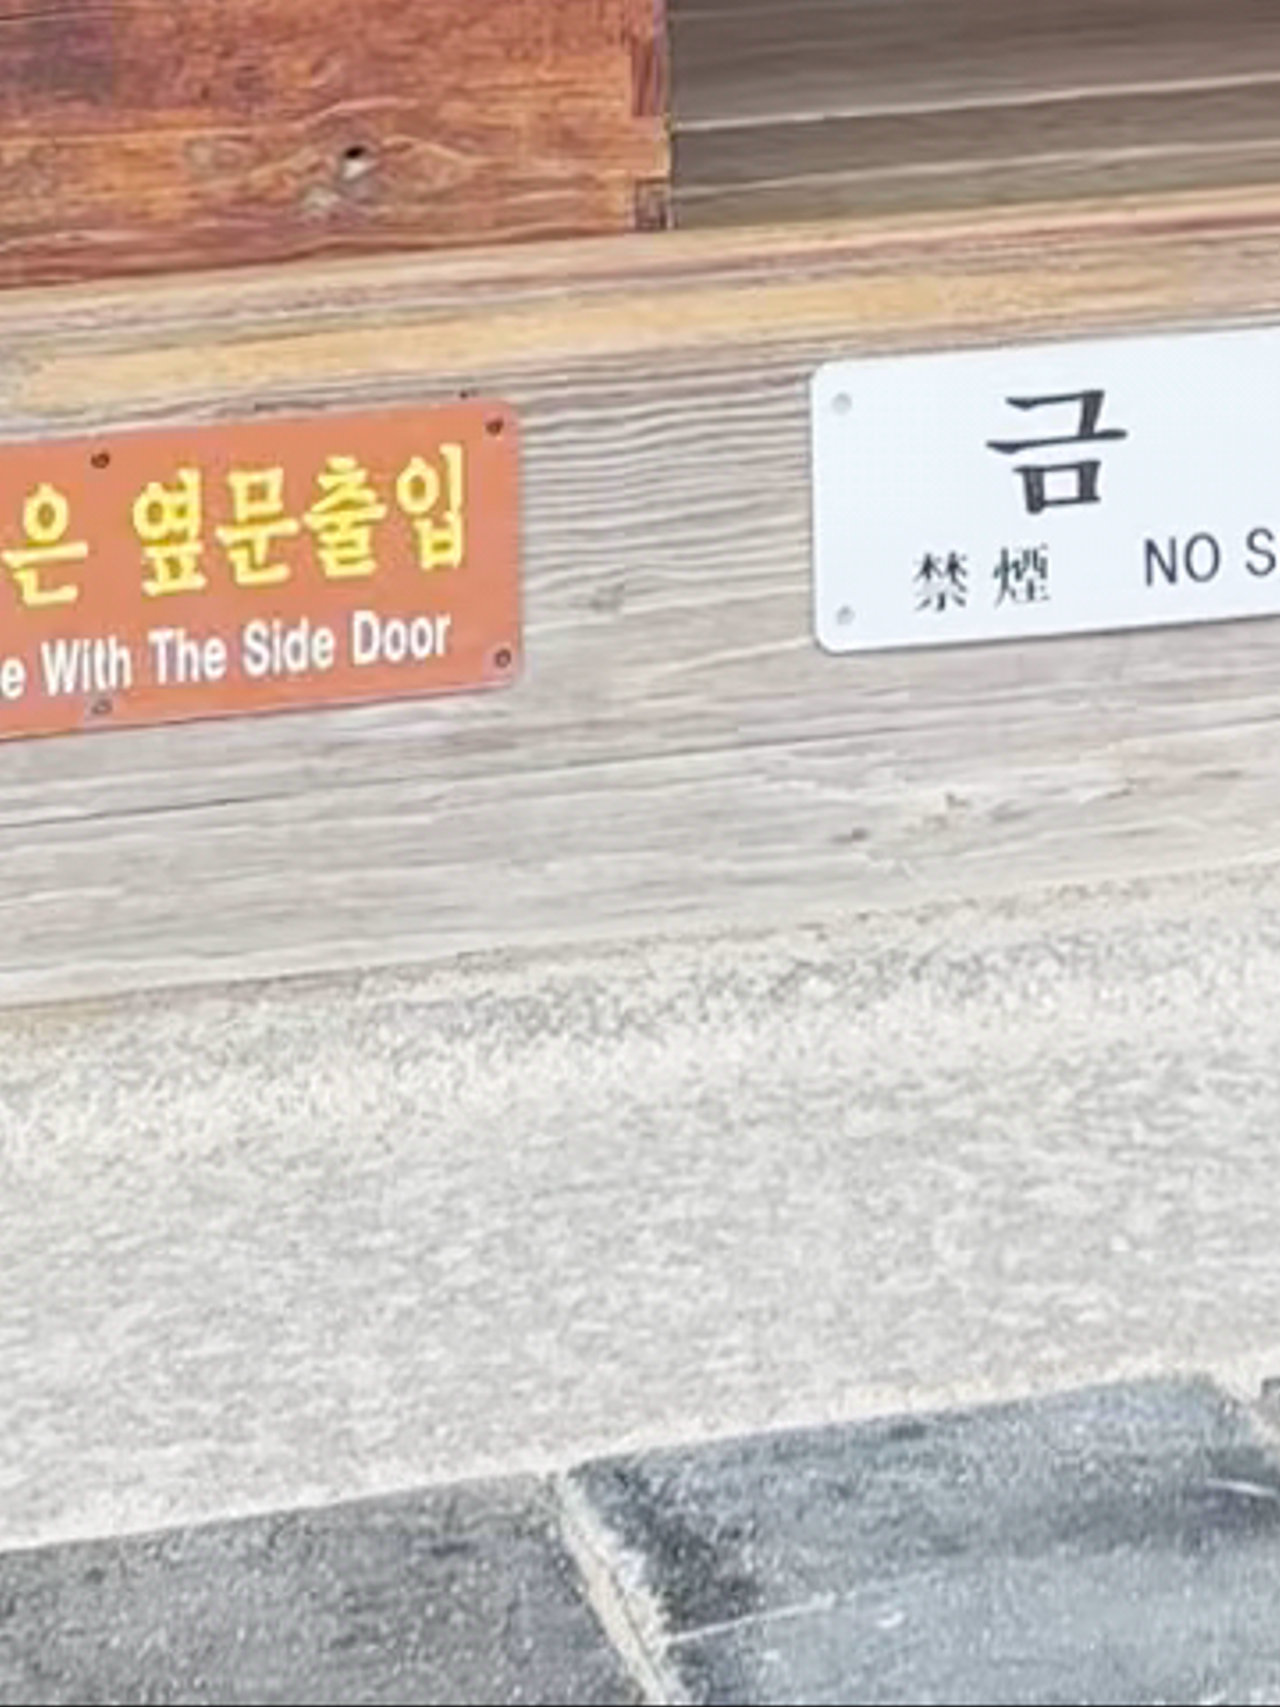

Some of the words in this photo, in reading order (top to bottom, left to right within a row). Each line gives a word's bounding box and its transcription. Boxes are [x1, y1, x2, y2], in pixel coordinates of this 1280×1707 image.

[132, 443, 465, 597] 옆문출입
[1145, 533, 1221, 586] NO
[41, 637, 131, 695] With
[149, 629, 227, 683] The
[244, 620, 335, 675] Side
[353, 611, 451, 663] Door
